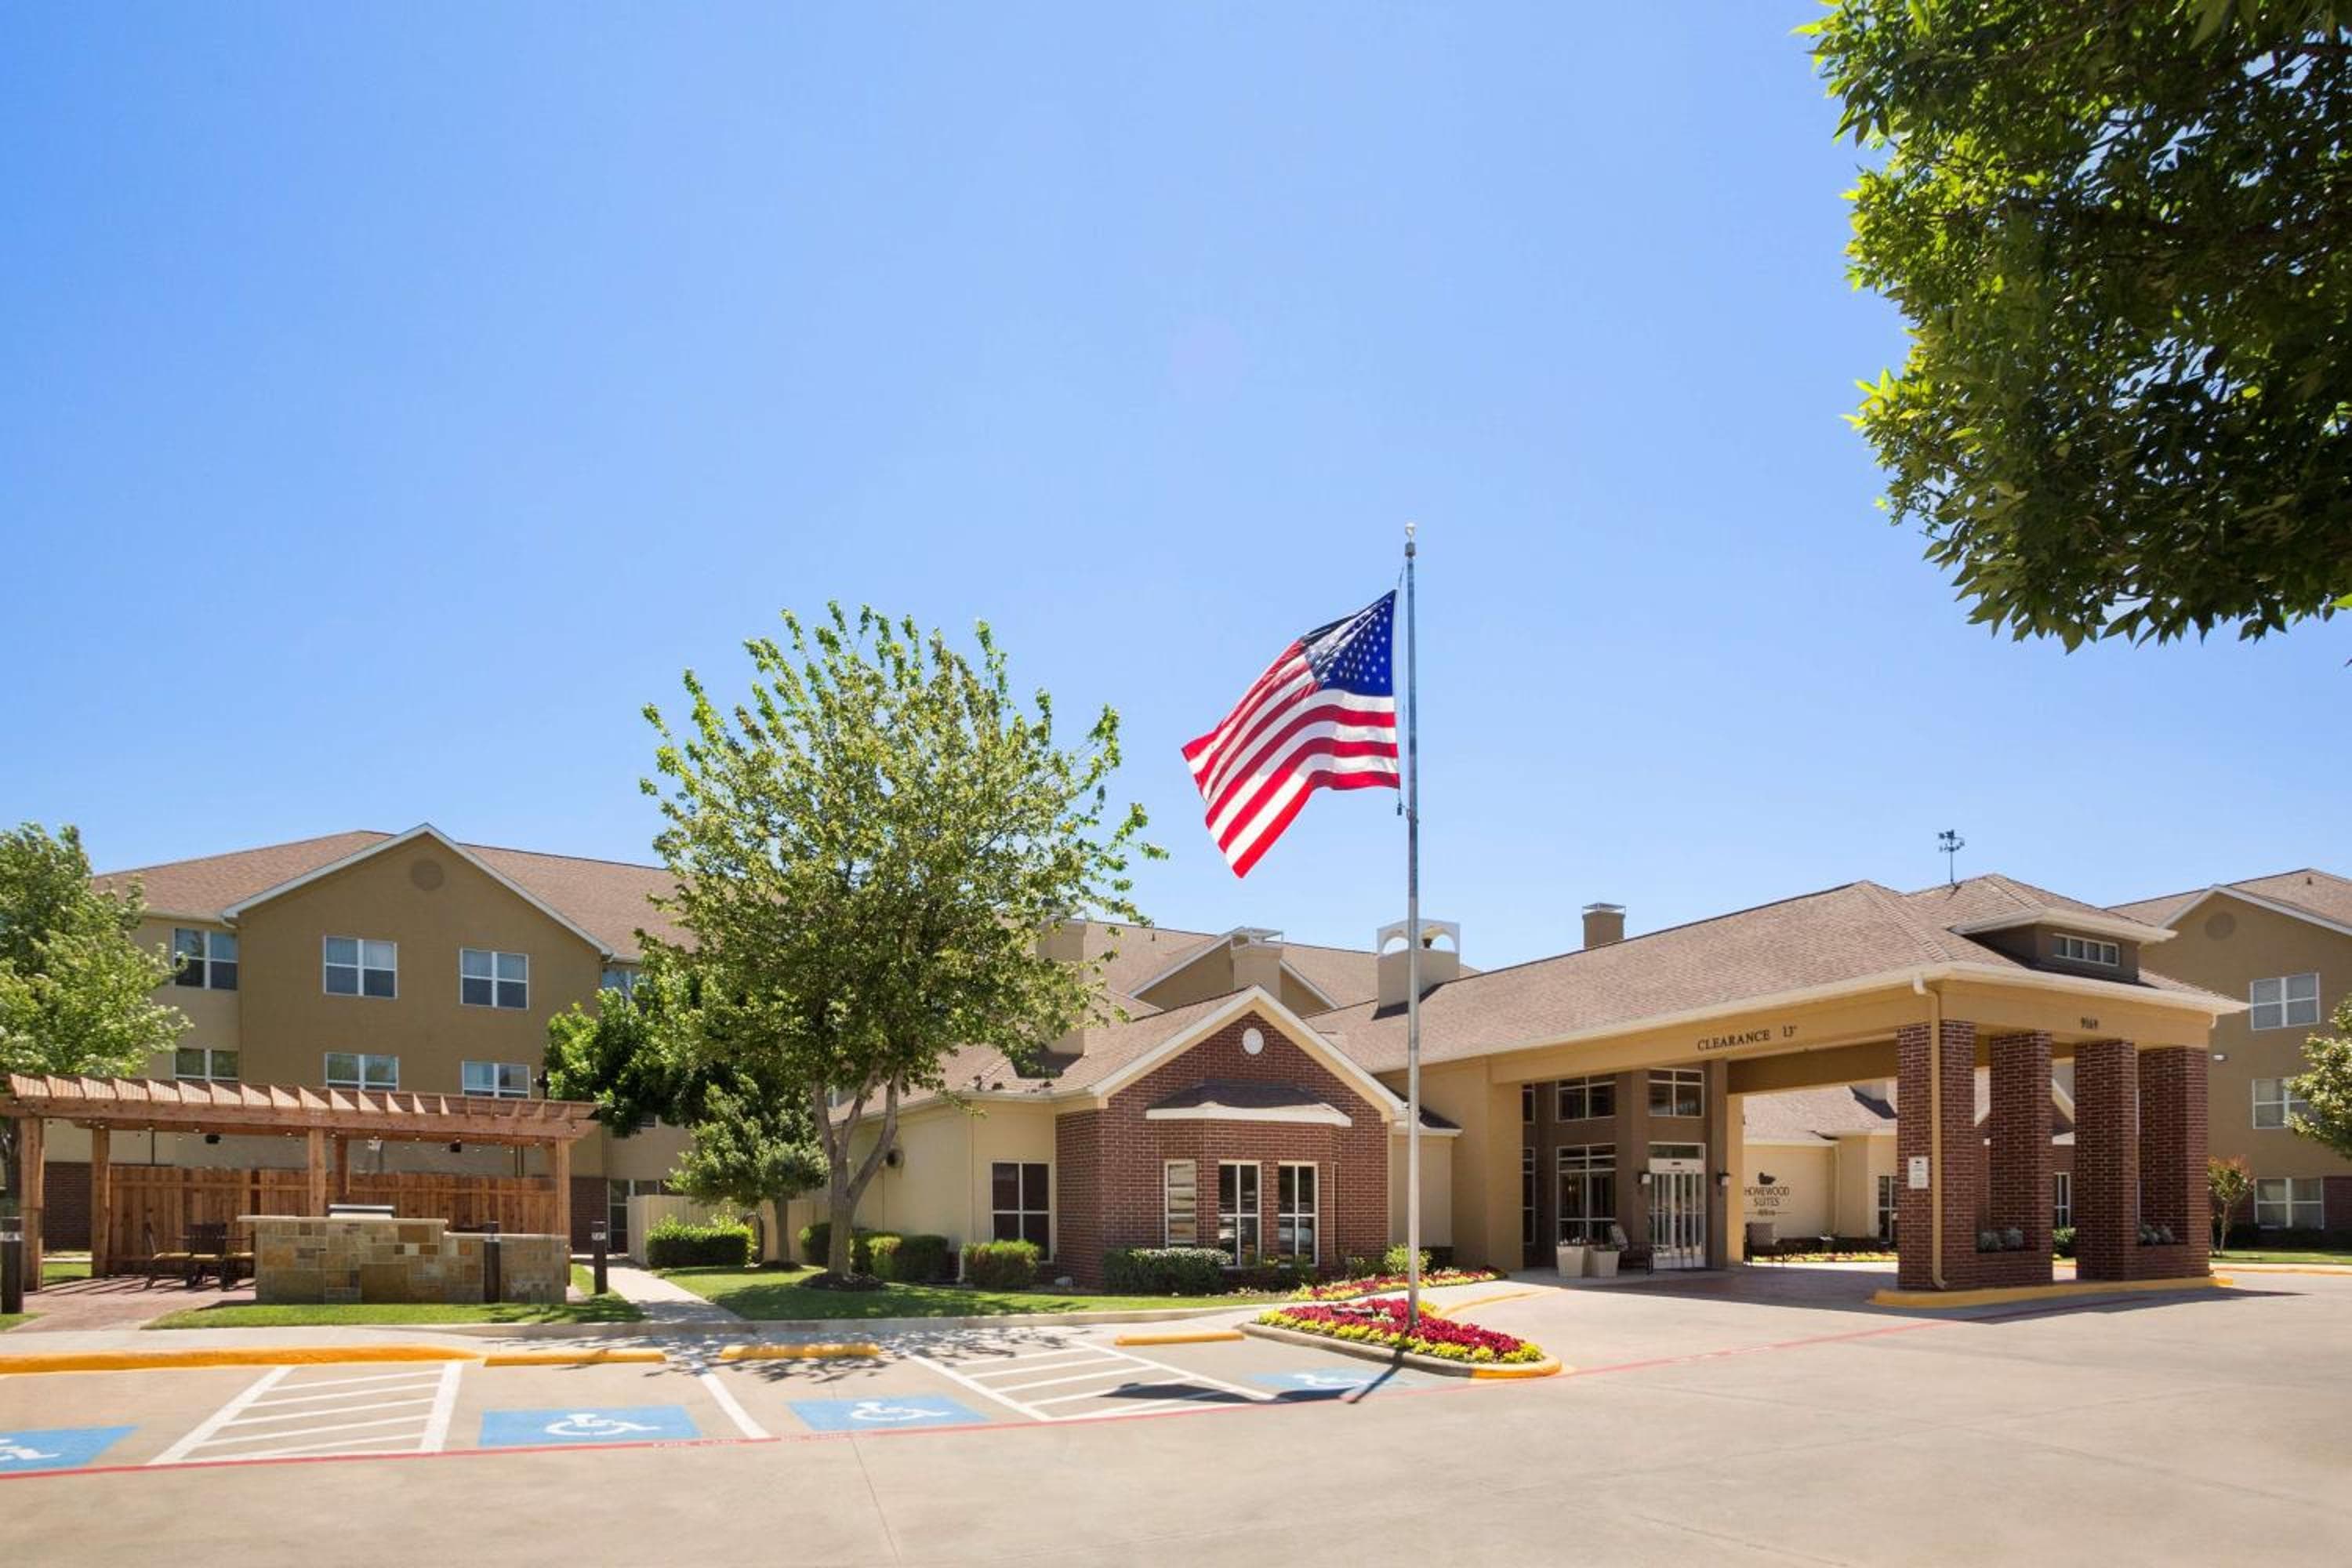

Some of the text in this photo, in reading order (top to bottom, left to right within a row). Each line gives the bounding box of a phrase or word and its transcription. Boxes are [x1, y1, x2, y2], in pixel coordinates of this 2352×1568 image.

[1697, 1029, 1770, 1051] CLEARANCE
[1744, 1186, 1790, 1196] HOMEWOOD
[1754, 1197, 1780, 1207] SUITES
